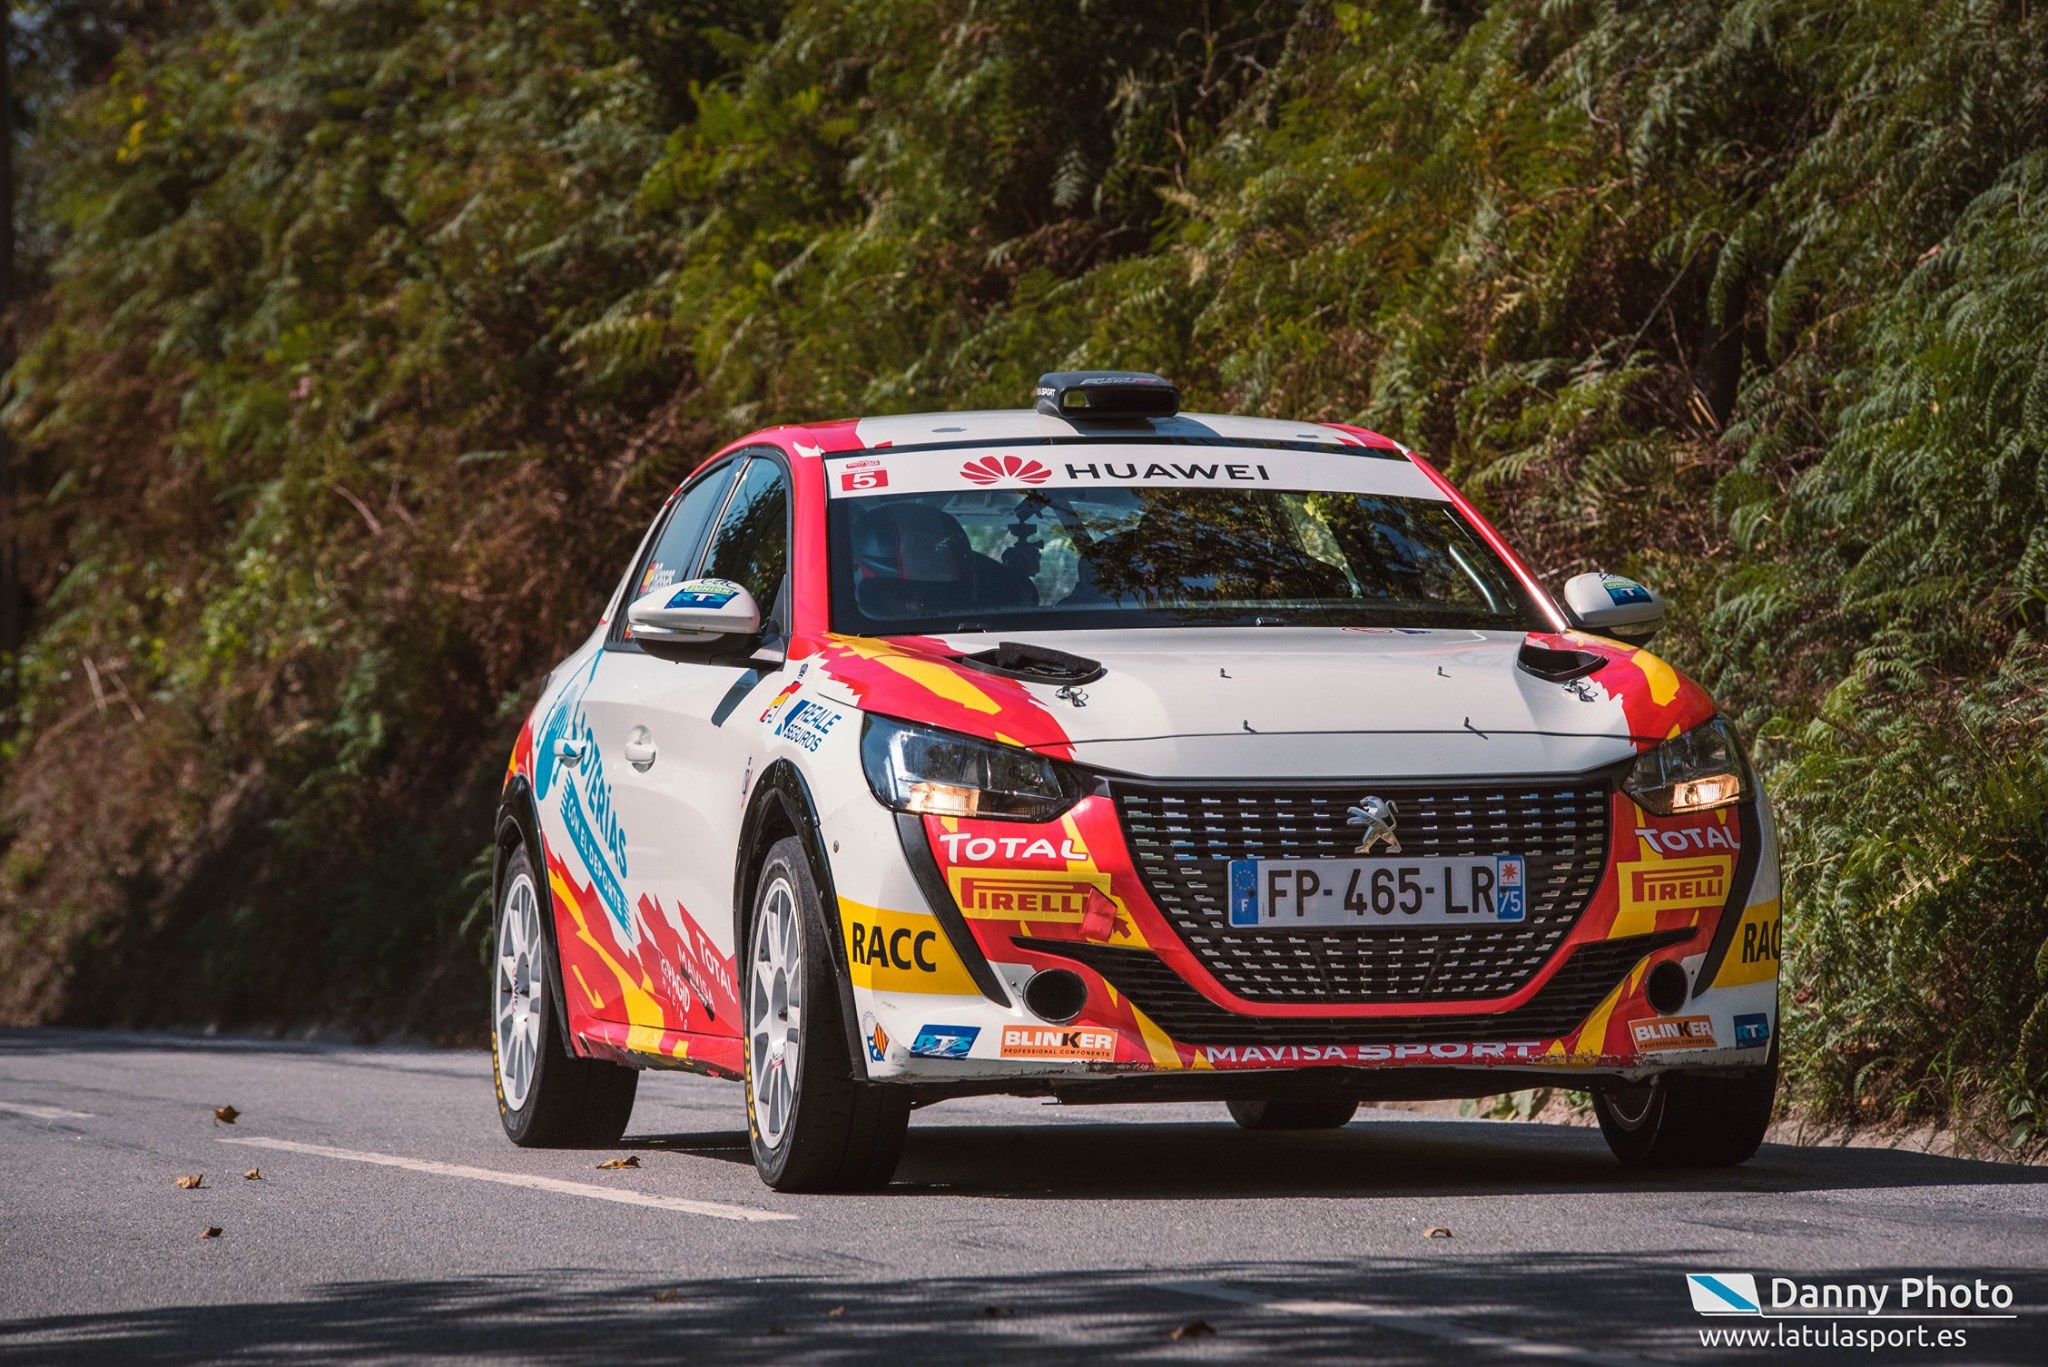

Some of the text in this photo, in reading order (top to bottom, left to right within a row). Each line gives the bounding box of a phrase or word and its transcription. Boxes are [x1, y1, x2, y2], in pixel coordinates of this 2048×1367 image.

[852, 471, 877, 489] 5
[1065, 463, 1270, 480] HUAWEI
[671, 593, 730, 602] RTS
[687, 585, 732, 594] JUNIOR
[797, 703, 842, 735] REALE
[783, 723, 823, 752] SEGUROS
[939, 833, 1089, 863] TOTAL
[1634, 826, 1741, 853] TOTAL
[568, 798, 623, 917] CON EL DEPORTE
[1631, 864, 1725, 903] PIRELLI
[1240, 898, 1250, 912] F
[1499, 890, 1521, 913] 75
[852, 921, 937, 973] RACC
[695, 930, 737, 1004] TOTAL
[1004, 1030, 1112, 1049] BLINKER
[1634, 1020, 1713, 1041] BLINKER
[1736, 1024, 1768, 1039] RTS
[915, 1034, 973, 1050] RTS
[1206, 1041, 1541, 1063] MAVISA SPORT
